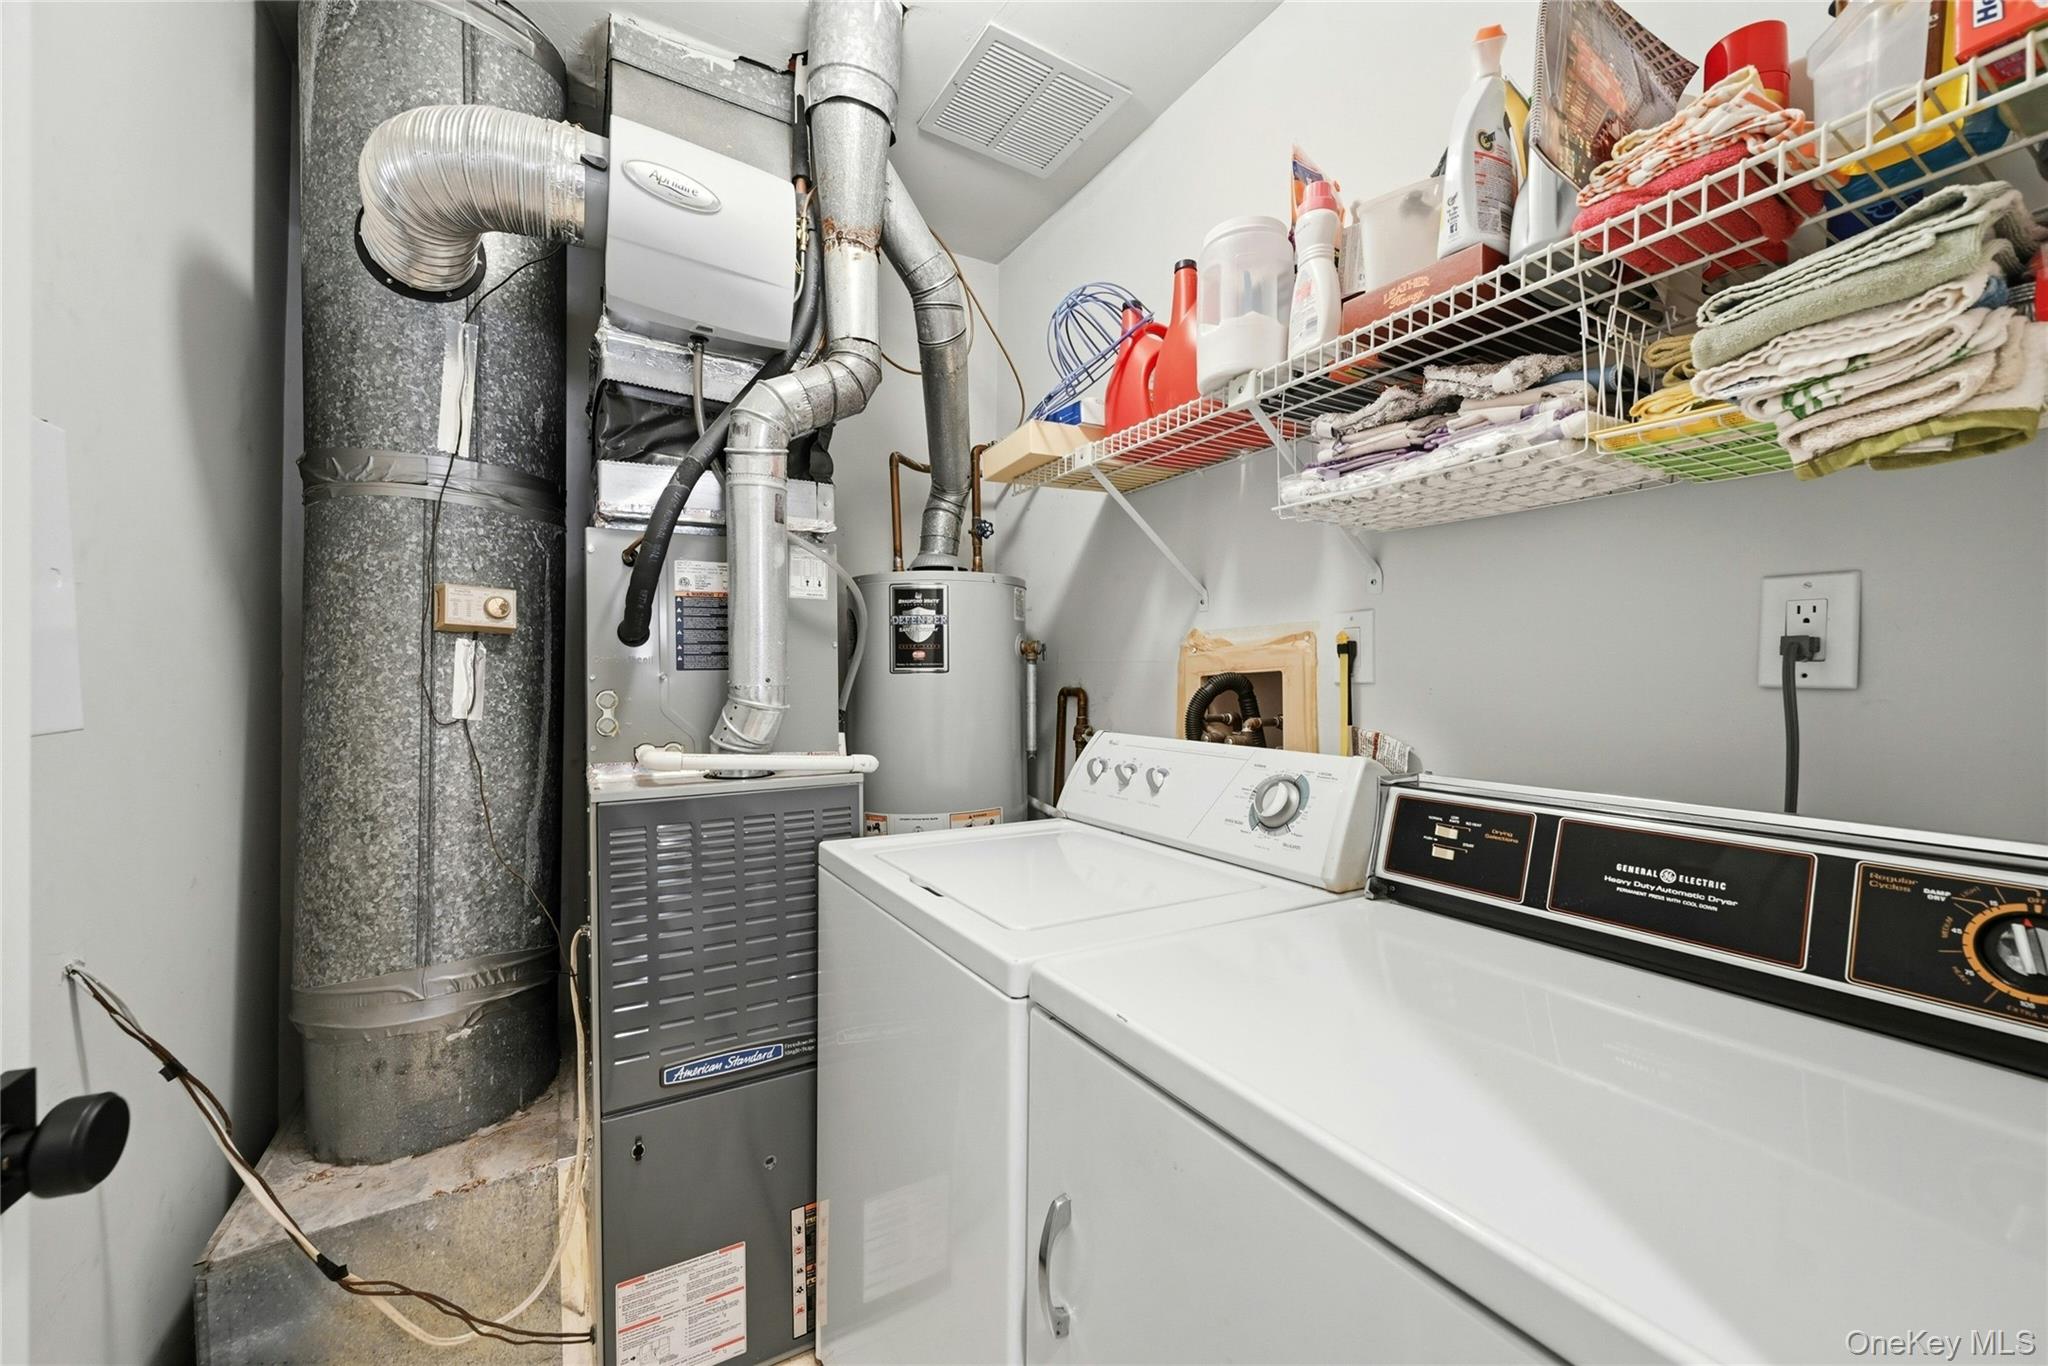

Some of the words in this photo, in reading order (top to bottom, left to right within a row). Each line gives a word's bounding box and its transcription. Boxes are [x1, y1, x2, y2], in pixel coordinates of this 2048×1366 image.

[1383, 276, 1431, 305] LEATHER
[891, 615, 947, 625] DEFENDER
[1616, 863, 1658, 878] GENERAL
[1679, 874, 1727, 891] ELECTRIC
[1868, 880, 1911, 893] Cycles
[1869, 872, 1919, 885] Regular
[1604, 875, 1631, 887] Heavy
[1633, 880, 1656, 892] Duty
[1655, 885, 1705, 900] Automatic
[1707, 895, 1739, 907] Dryer
[1616, 886, 1647, 897] PERMANENT
[1648, 893, 1665, 901] PRESS
[1682, 900, 1698, 908] COOL
[1698, 903, 1718, 912] DOWN
[1923, 887, 1952, 897] DAMP
[1926, 894, 1947, 902] DRY
[672, 1061, 722, 1082] American
[725, 1046, 776, 1069] Standard
